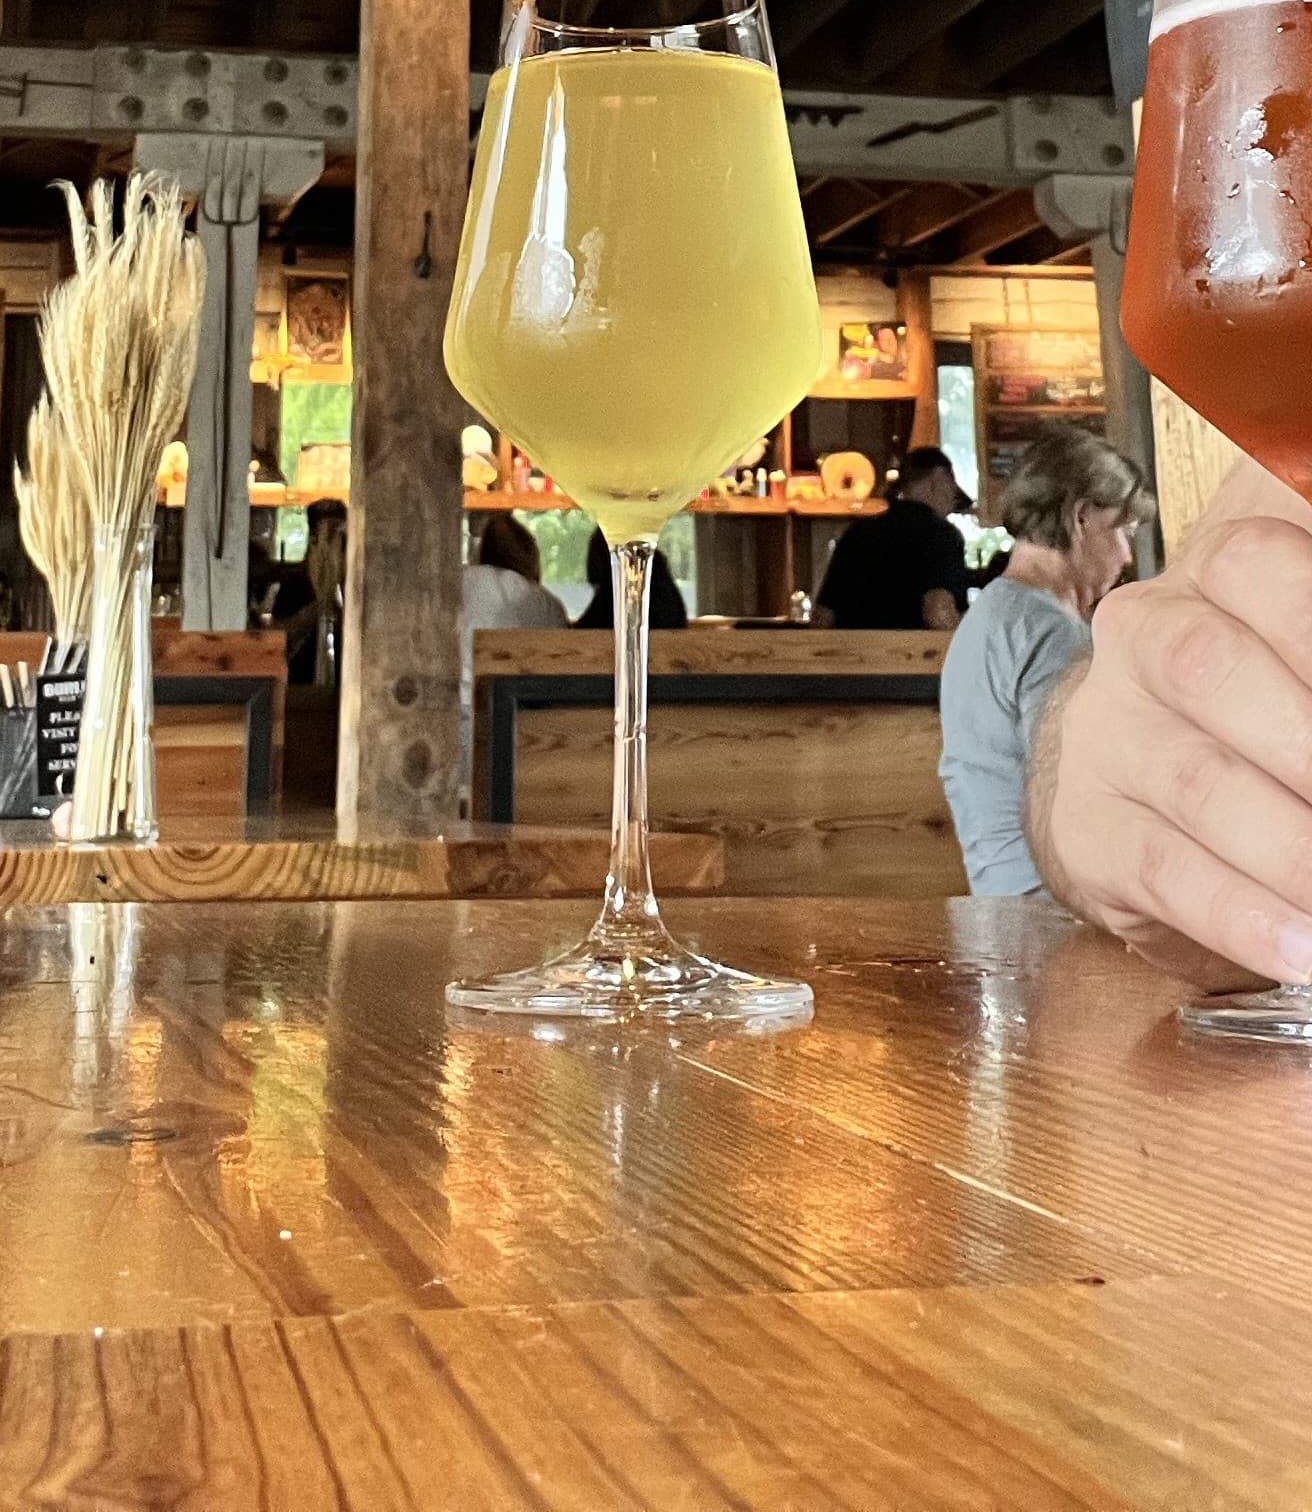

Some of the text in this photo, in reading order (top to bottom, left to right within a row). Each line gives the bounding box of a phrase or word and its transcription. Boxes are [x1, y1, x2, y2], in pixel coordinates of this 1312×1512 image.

[49, 710, 80, 724] PLEA
[61, 742, 77, 754] FO
[48, 759, 76, 771] SERV
